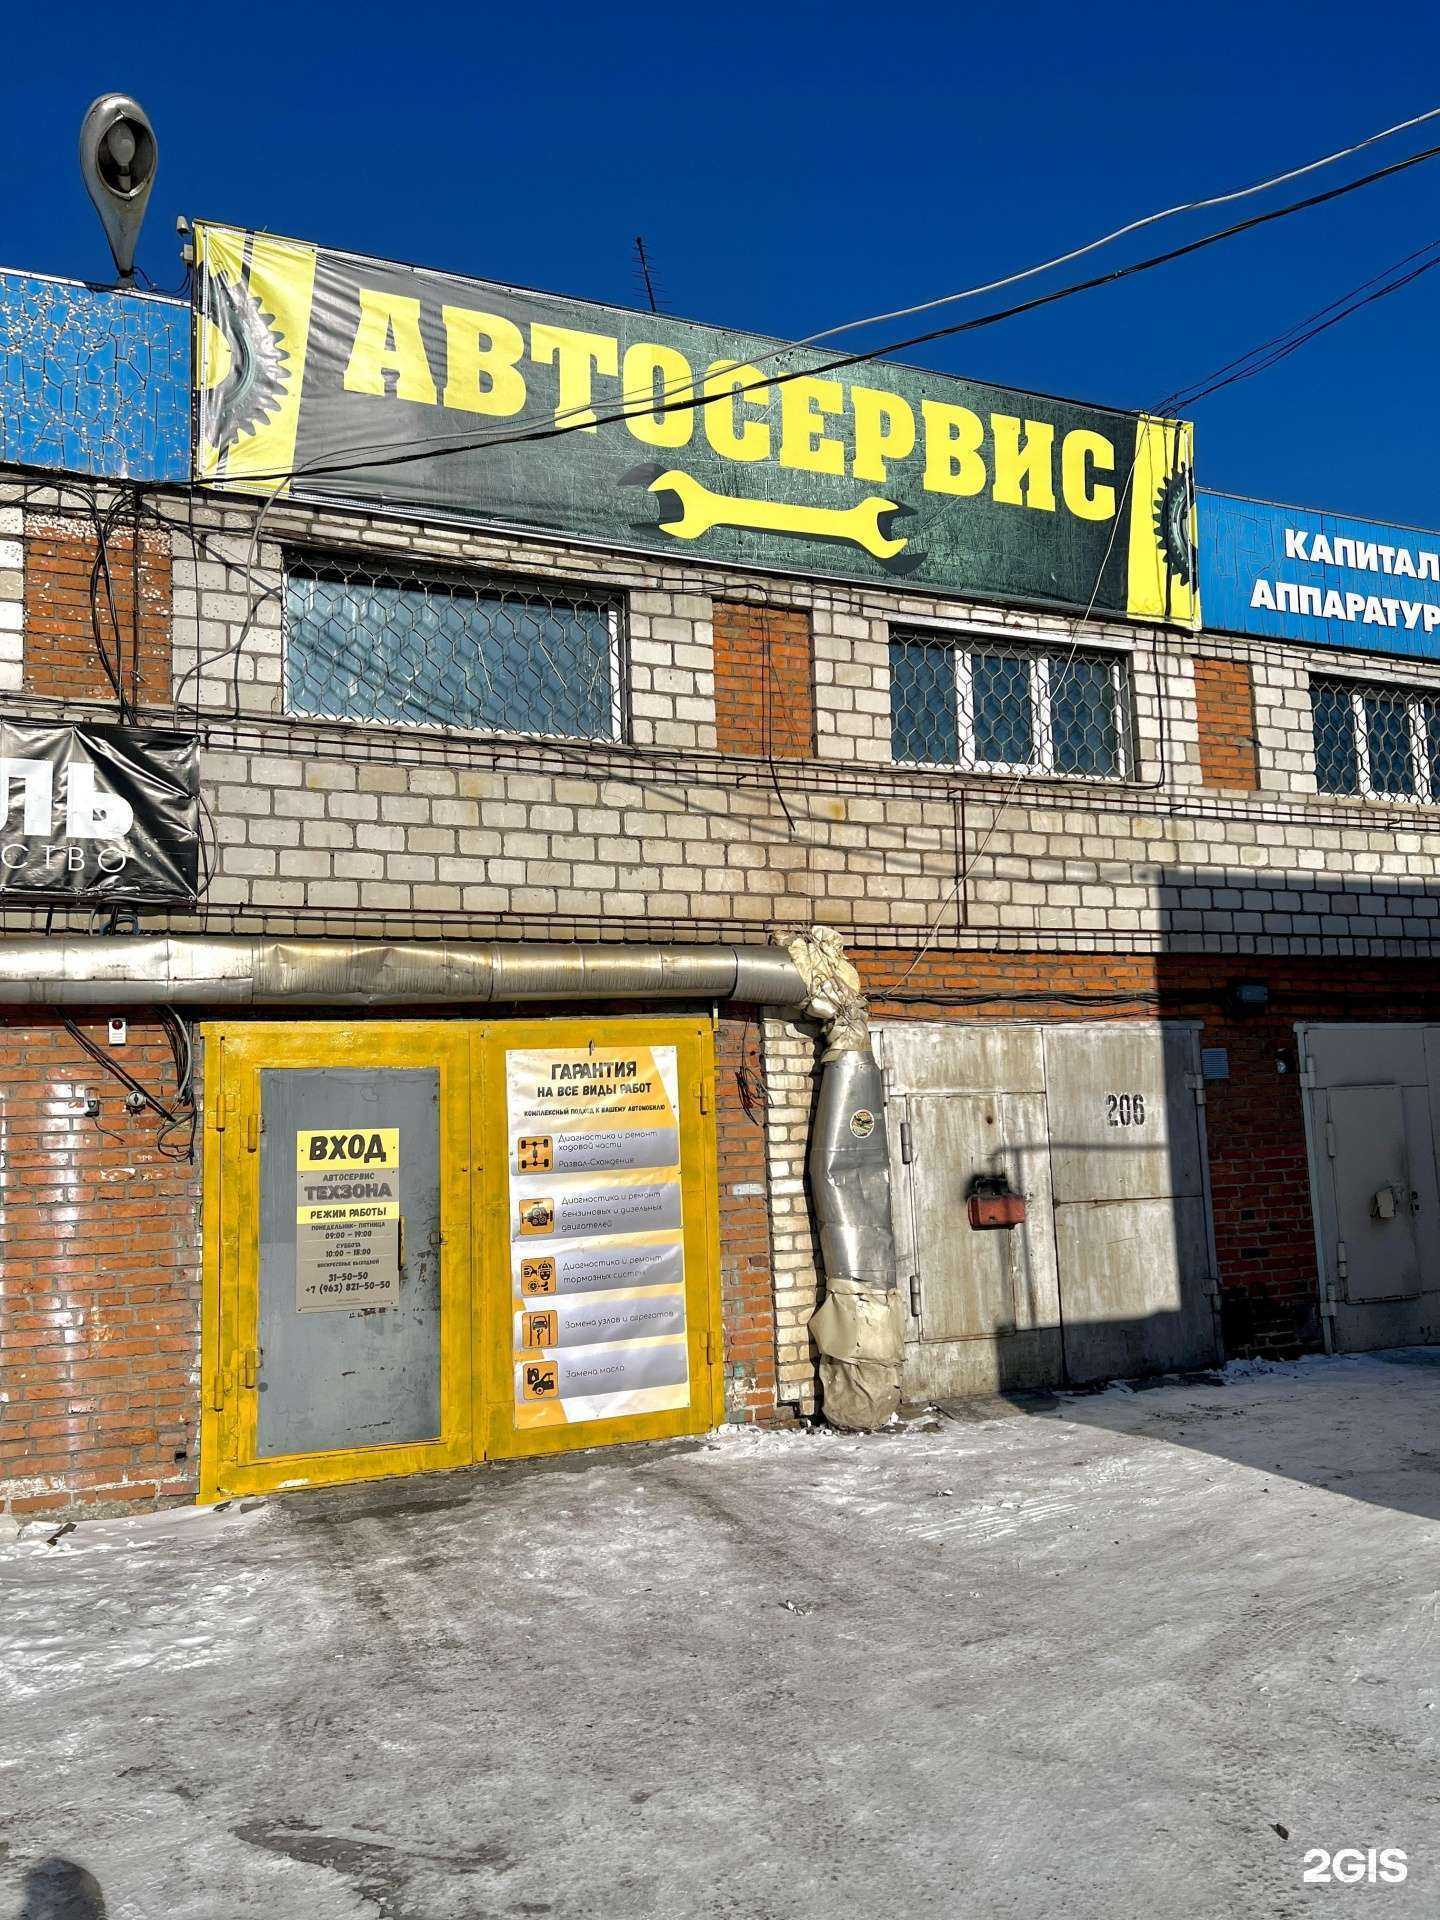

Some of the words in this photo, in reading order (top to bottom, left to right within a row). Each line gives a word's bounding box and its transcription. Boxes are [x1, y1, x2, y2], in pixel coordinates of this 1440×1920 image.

[344, 287, 1118, 522] АВТОСЕРВИС
[1285, 528, 1440, 581] КАПИТАЛ
[1250, 579, 1440, 632] АППАРАТУР
[1, 843, 126, 873] СТВО
[551, 1061, 637, 1080] ГАРАНТИЯ
[537, 1086, 553, 1098] НА
[557, 1085, 579, 1097] ВСЕ
[582, 1083, 617, 1097] ВИДЫ
[620, 1083, 652, 1095] РАБОТ
[601, 1105, 626, 1113] ВАШЕМУ
[628, 1104, 666, 1112] АВТОМОБИЛЮ
[1106, 1094, 1145, 1126] 206
[558, 1133, 616, 1143] Диагностика
[625, 1131, 658, 1140] ремонт
[309, 1134, 387, 1163] ВХОД
[558, 1142, 594, 1152] ходовой
[595, 1141, 622, 1149] части
[322, 1172, 375, 1182] АВТОСЕРВИС
[304, 1182, 393, 1201] ТЕХЗОНА
[562, 1194, 620, 1205] Диагностика
[628, 1191, 661, 1201] ремонт
[310, 1208, 347, 1219] РЕЖИМ
[349, 1207, 387, 1217] РАБОТЫ
[562, 1206, 611, 1218] бензиновых
[621, 1203, 662, 1214] дизельных
[561, 1219, 613, 1231] двигателей
[325, 1231, 345, 1239] 09:00
[354, 1230, 372, 1238] 19:00
[326, 1250, 344, 1258] 10:00
[563, 1259, 620, 1271] Диагностика
[629, 1255, 663, 1265] ремонт
[328, 1271, 369, 1282] 31-50-50
[563, 1273, 612, 1284] тормозных
[305, 1285, 316, 1294] +7
[319, 1283, 343, 1294] (963)
[345, 1280, 391, 1292] 821-50-50
[565, 1319, 596, 1329] Замена
[598, 1316, 621, 1327] узлов
[565, 1369, 598, 1378] Замена
[600, 1365, 625, 1374] масла
